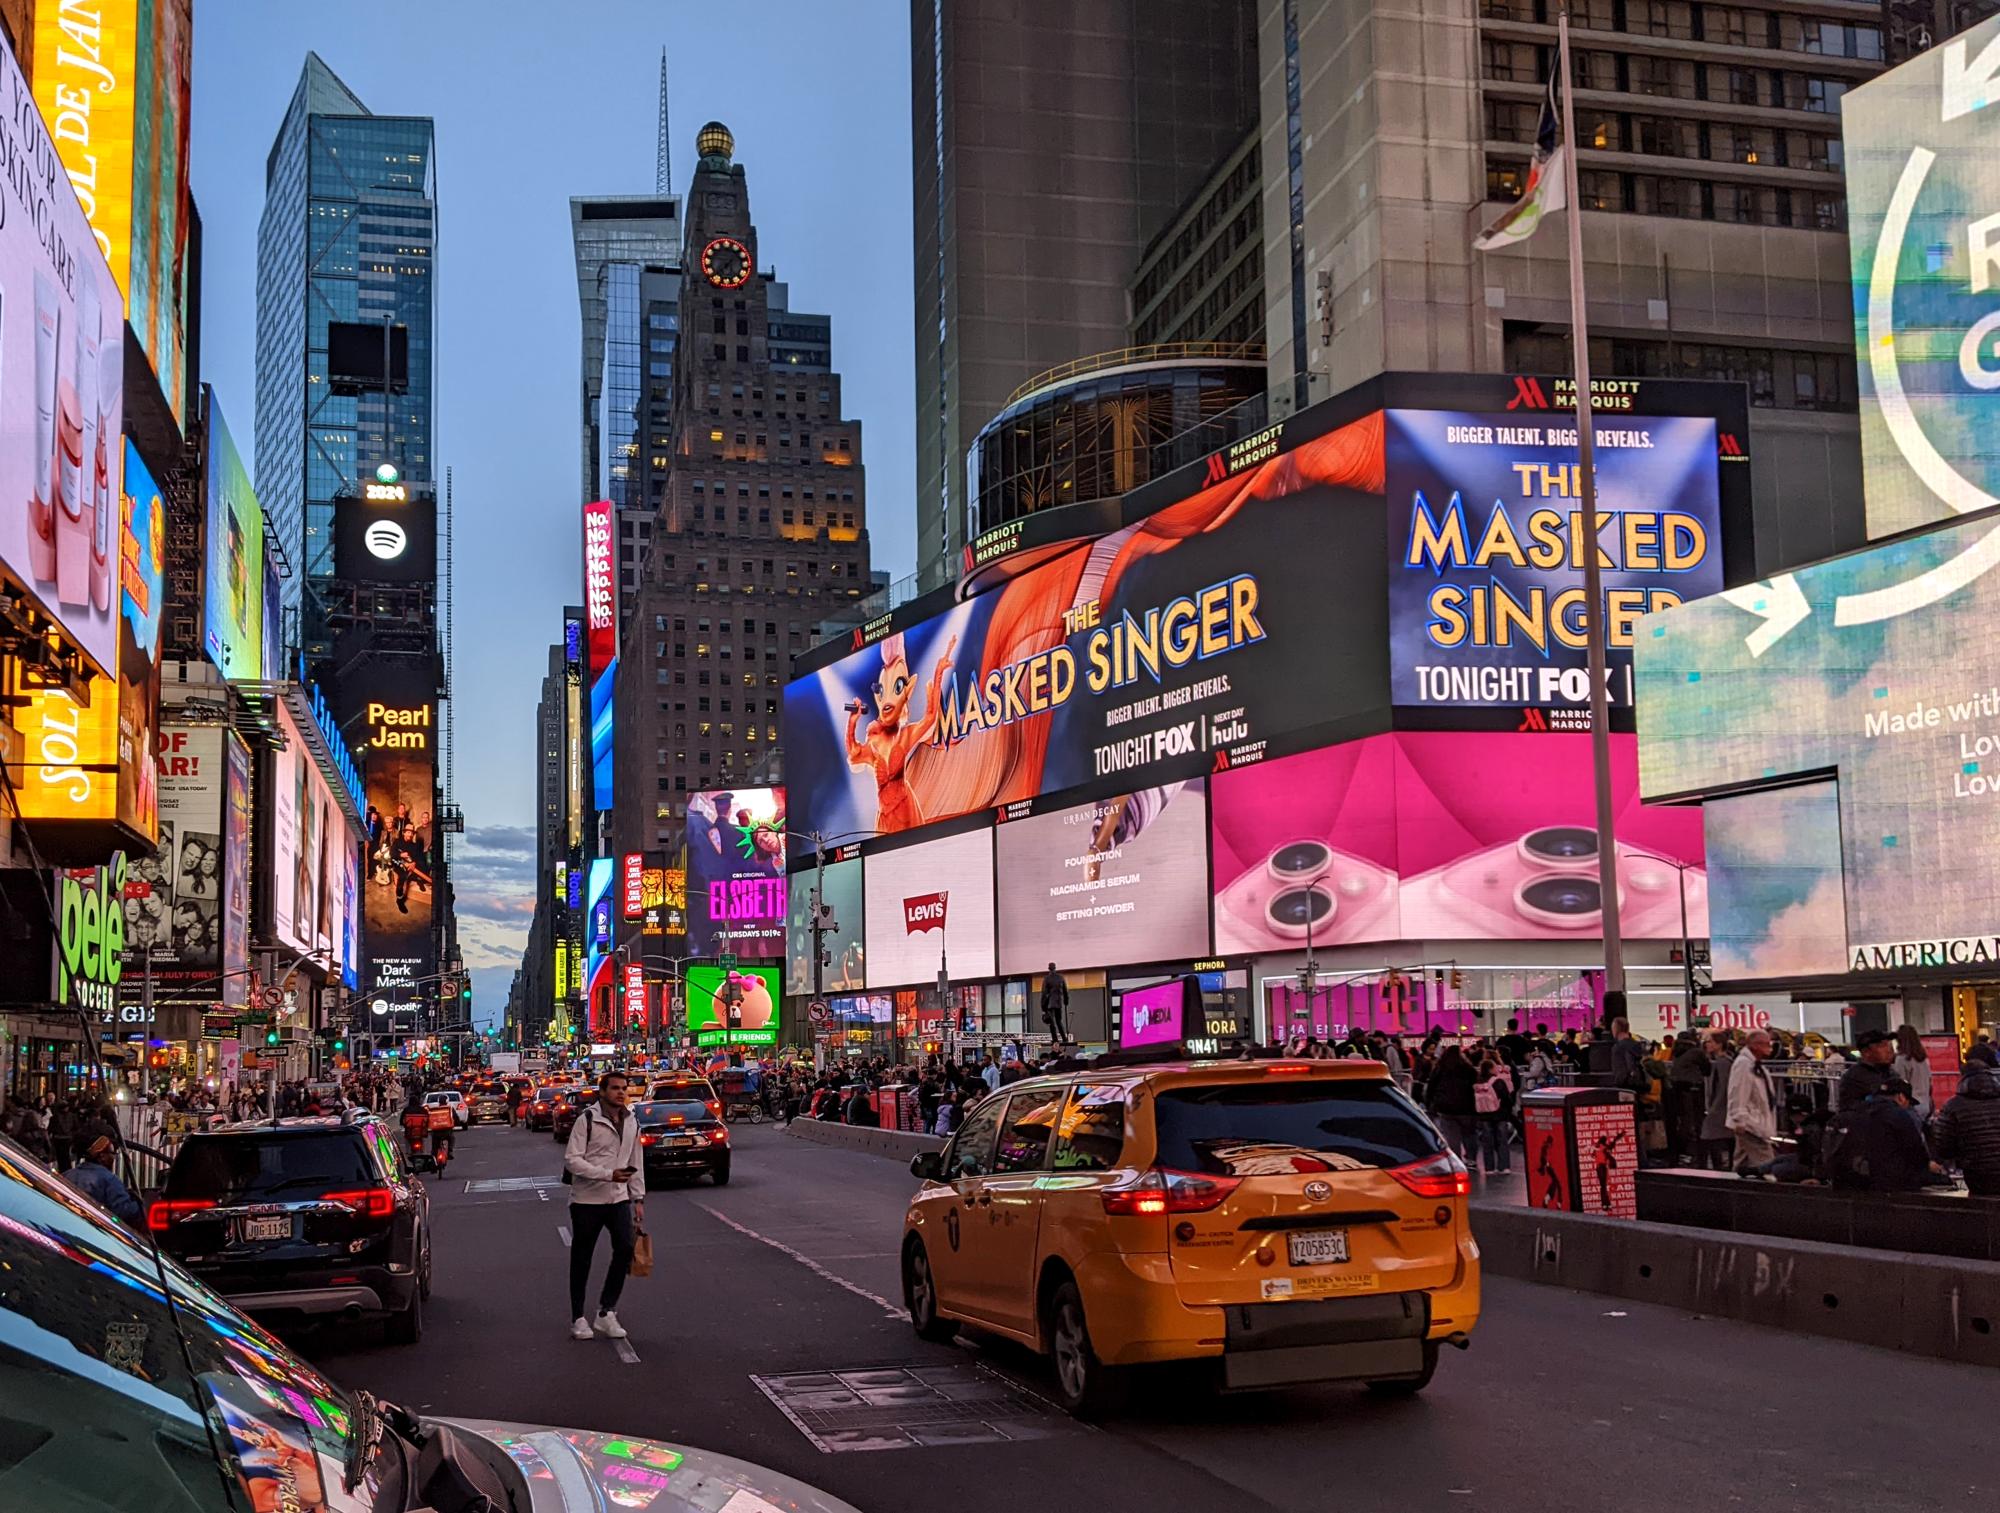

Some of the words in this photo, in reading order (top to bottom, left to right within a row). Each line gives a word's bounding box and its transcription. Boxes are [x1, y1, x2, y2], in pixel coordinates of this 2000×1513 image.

[55, 83, 91, 146] DE
[12, 68, 57, 206] YOUR
[1555, 379, 1640, 393] MARIOTT
[1555, 394, 1632, 408] MAQUIS
[1230, 424, 1284, 457] MARRIOTT
[1447, 426, 1493, 444] BIGGER
[1496, 427, 1544, 446] TALENT.
[1547, 428, 1578, 447] BIGG
[1596, 430, 1654, 448] REVEALS.
[1231, 441, 1278, 471] MARQUIS
[366, 485, 406, 500] 2024
[586, 511, 608, 528] No.
[587, 527, 609, 543] No.
[976, 521, 1024, 549] MARRIOTT
[1405, 491, 1711, 577] MASKED
[587, 542, 610, 559] No.
[976, 538, 1018, 563] MARQUIS
[588, 558, 610, 574] No.
[589, 573, 611, 589] No.
[589, 588, 612, 604] No.
[865, 613, 892, 632] MARRIOTT
[1062, 599, 1100, 637] THE
[865, 625, 890, 642] MARQUIS
[932, 644, 1076, 751] MASKED
[1086, 573, 1267, 694] SINGER
[1416, 666, 1533, 701] TONIGHT
[1106, 706, 1132, 727] BIGGER
[1133, 695, 1162, 719] TALENT.
[1163, 686, 1191, 710] BIGGER
[1192, 675, 1231, 701] REVEALS.
[368, 703, 429, 726] Pearl
[1214, 711, 1231, 723] NEXT
[1231, 707, 1245, 719] DAY
[1864, 702, 1941, 738] Made
[371, 726, 425, 748] Jam
[40, 707, 90, 802] SOL
[1094, 733, 1152, 776] TONIGHT
[1154, 721, 1195, 761] FOX
[1211, 721, 1248, 746] hulu
[1231, 740, 1267, 756] MARRIOTT
[1231, 751, 1263, 766] MARQUIS
[1008, 800, 1032, 812] MARRIOTT
[1008, 808, 1030, 819] MARQUIS
[1063, 811, 1090, 825] URBAN
[1092, 804, 1120, 818] DECAY
[1064, 849, 1122, 868] FOUNDATION
[1050, 880, 1106, 896] NIACINAMIDE
[1107, 873, 1140, 888] SERUM
[1056, 908, 1092, 921] SETTING
[1094, 902, 1135, 916] POWDER
[382, 964, 411, 976] Dark
[1194, 961, 1226, 971] SEPHORA
[1133, 1004, 1150, 1034] lyft
[1149, 1007, 1172, 1024] MEDIA
[267, 1222, 289, 1236] 1125
[1293, 1238, 1342, 1257] Y205853C
